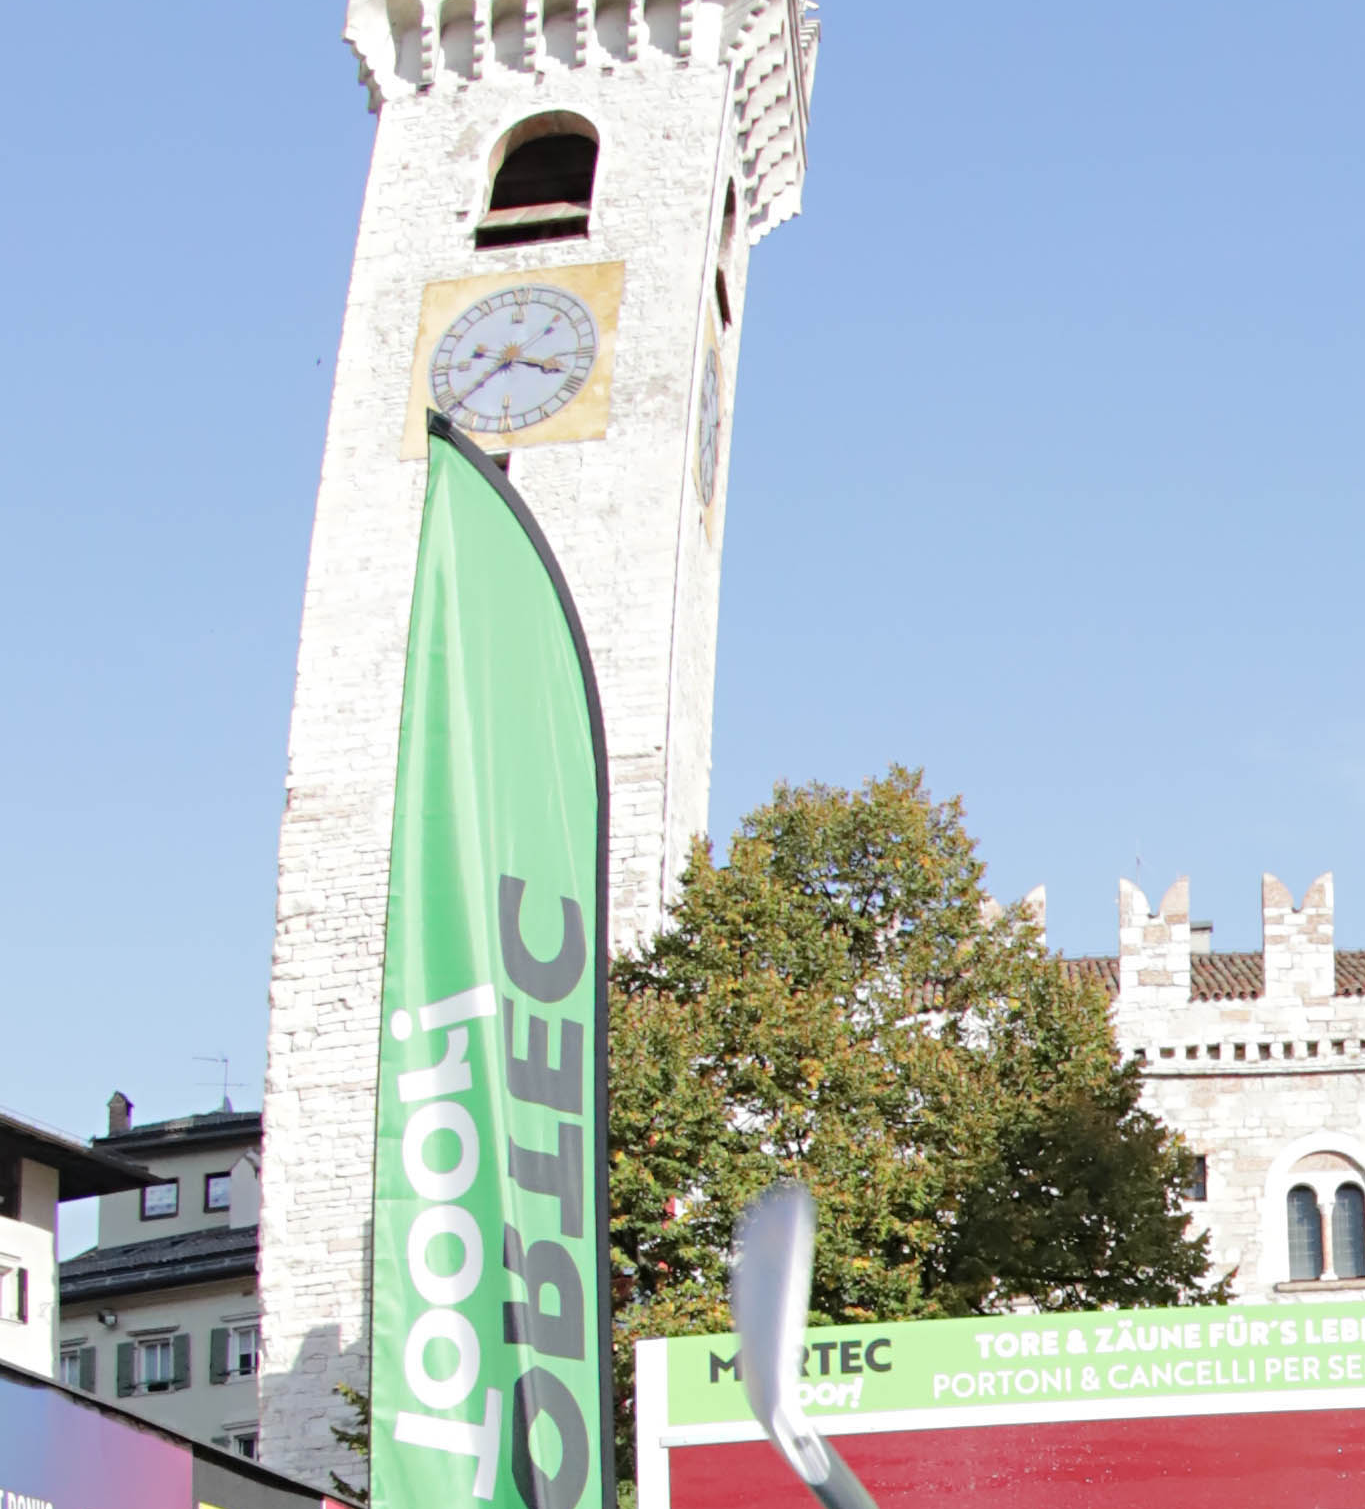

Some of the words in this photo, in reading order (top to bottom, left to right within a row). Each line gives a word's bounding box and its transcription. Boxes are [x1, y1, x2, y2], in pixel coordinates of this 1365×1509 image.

[710, 1338, 892, 1383] MRTEC
[975, 1330, 1060, 1359] TORE
[1066, 1329, 1088, 1354] &
[1095, 1319, 1202, 1354] ZÄUNE
[933, 1368, 1071, 1399] PORTONI
[1081, 1366, 1101, 1391] &
[1107, 1359, 1256, 1390] CANCELLI
[1264, 1354, 1321, 1383] PER
